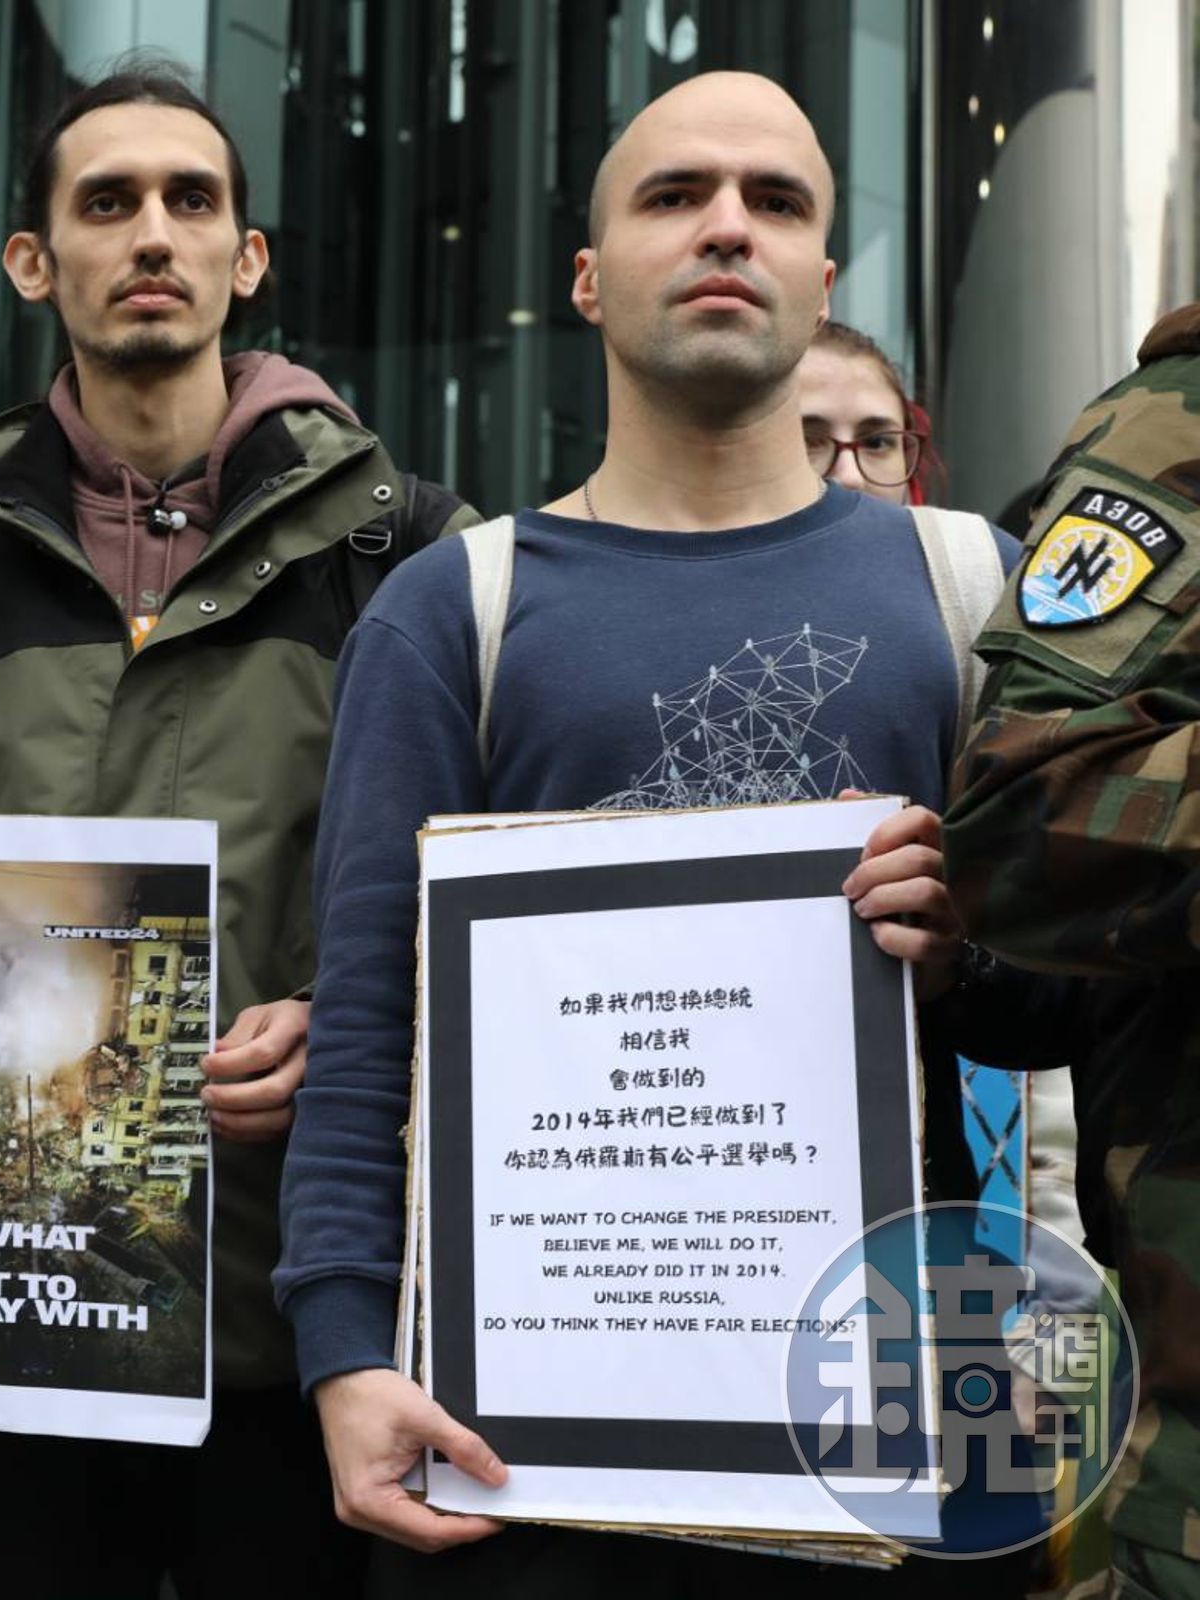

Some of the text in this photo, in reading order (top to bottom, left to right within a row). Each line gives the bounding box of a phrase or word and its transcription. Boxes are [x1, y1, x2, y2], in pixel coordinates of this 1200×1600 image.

[45, 927, 159, 939] UNITED24
[559, 987, 753, 1015] 如果我們想換總統
[620, 1028, 690, 1051] 相信我
[609, 1068, 704, 1091] 會做到的
[532, 1103, 786, 1131] 2014年我們已經做到了
[490, 1210, 836, 1226] IF WE WANT TO CHANGE THE PRESIDENT,
[544, 1238, 783, 1252] BELIEVE ME, WE WILL DO IT,
[542, 1264, 786, 1278] WE ALREADY DID IT IN 2014.
[18, 1274, 76, 1300] TO
[595, 1291, 724, 1306] UNLIKE RUSSIA,
[33, 1300, 148, 1331] WITH
[484, 1317, 856, 1333] DO YOU THINK THEY HAVE FAIR ELECTIONS?
